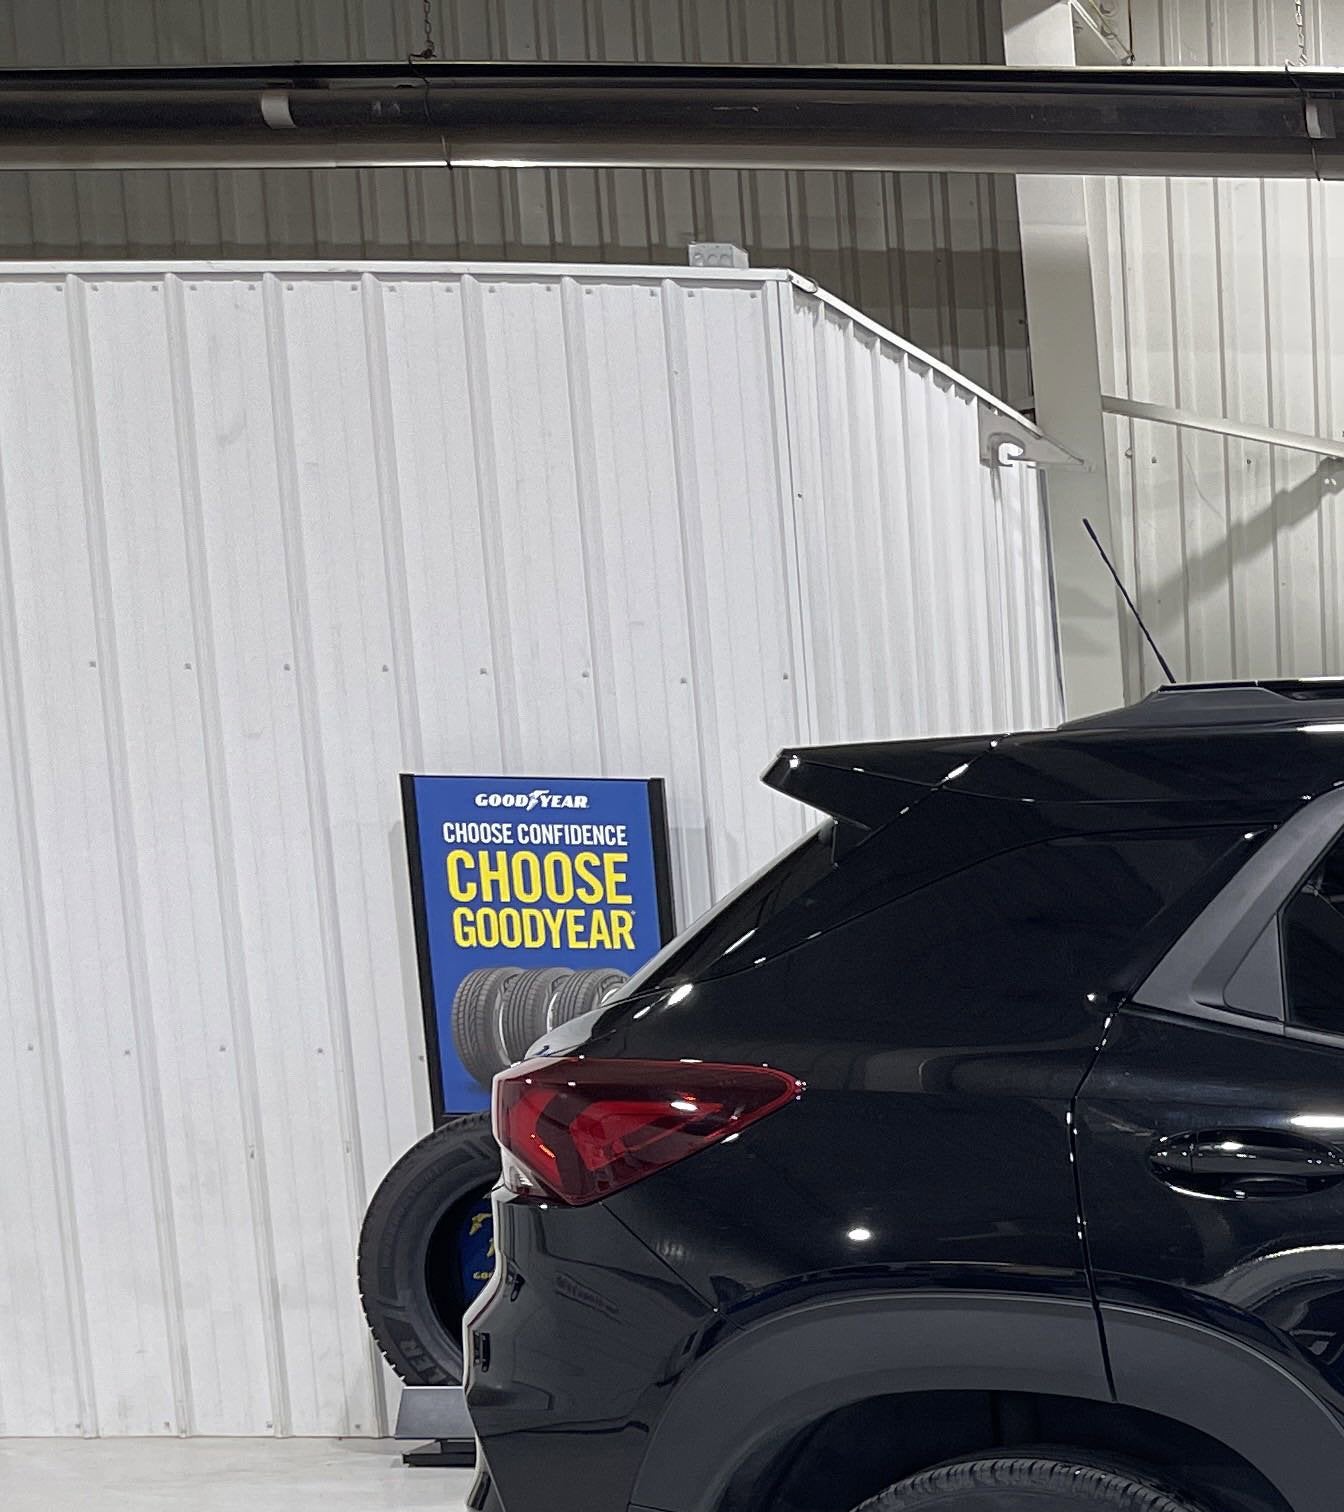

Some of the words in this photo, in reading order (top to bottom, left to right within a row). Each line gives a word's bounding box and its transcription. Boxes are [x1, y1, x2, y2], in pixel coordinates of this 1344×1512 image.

[474, 790, 590, 810] GOODYEAR
[442, 822, 514, 844] CHOOSE
[517, 823, 628, 846] CONFIDENCE
[446, 849, 632, 905] CHOOSE
[452, 906, 636, 950] GOODYEAR
